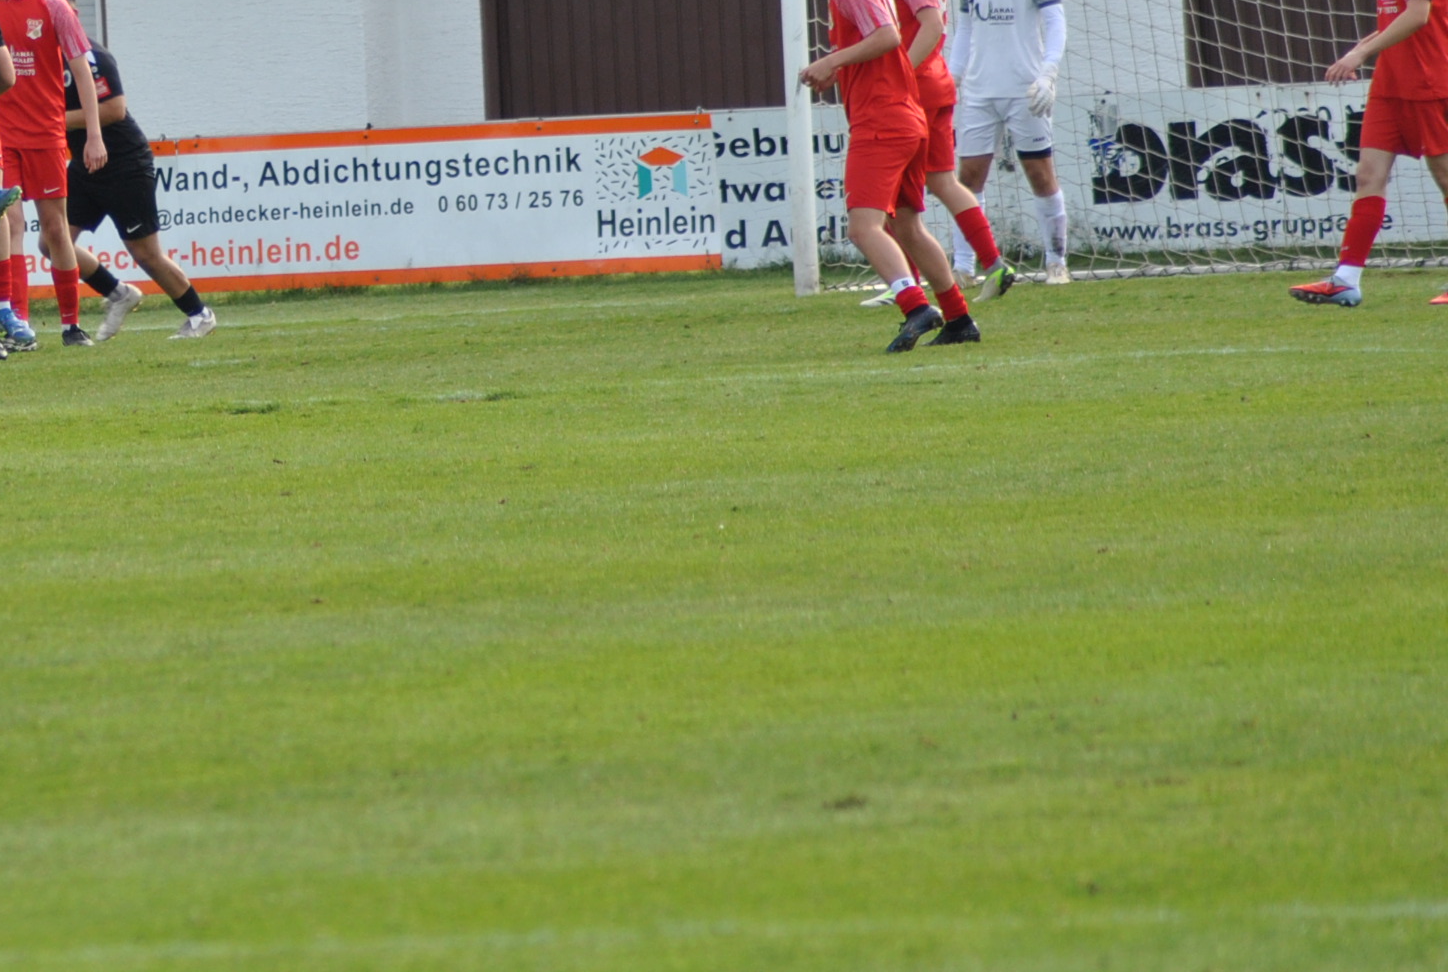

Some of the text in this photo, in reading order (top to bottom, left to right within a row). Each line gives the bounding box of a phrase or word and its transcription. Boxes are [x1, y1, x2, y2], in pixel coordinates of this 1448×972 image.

[258, 146, 582, 188] Abdichtungstechnik
[455, 194, 478, 212] 60
[486, 192, 508, 211] 73
[528, 191, 553, 208] 25
[560, 189, 585, 207] 76
[596, 206, 716, 238] Heinlein
[761, 215, 849, 248] Adi
[1094, 213, 1393, 241] www.brass-gruppee
